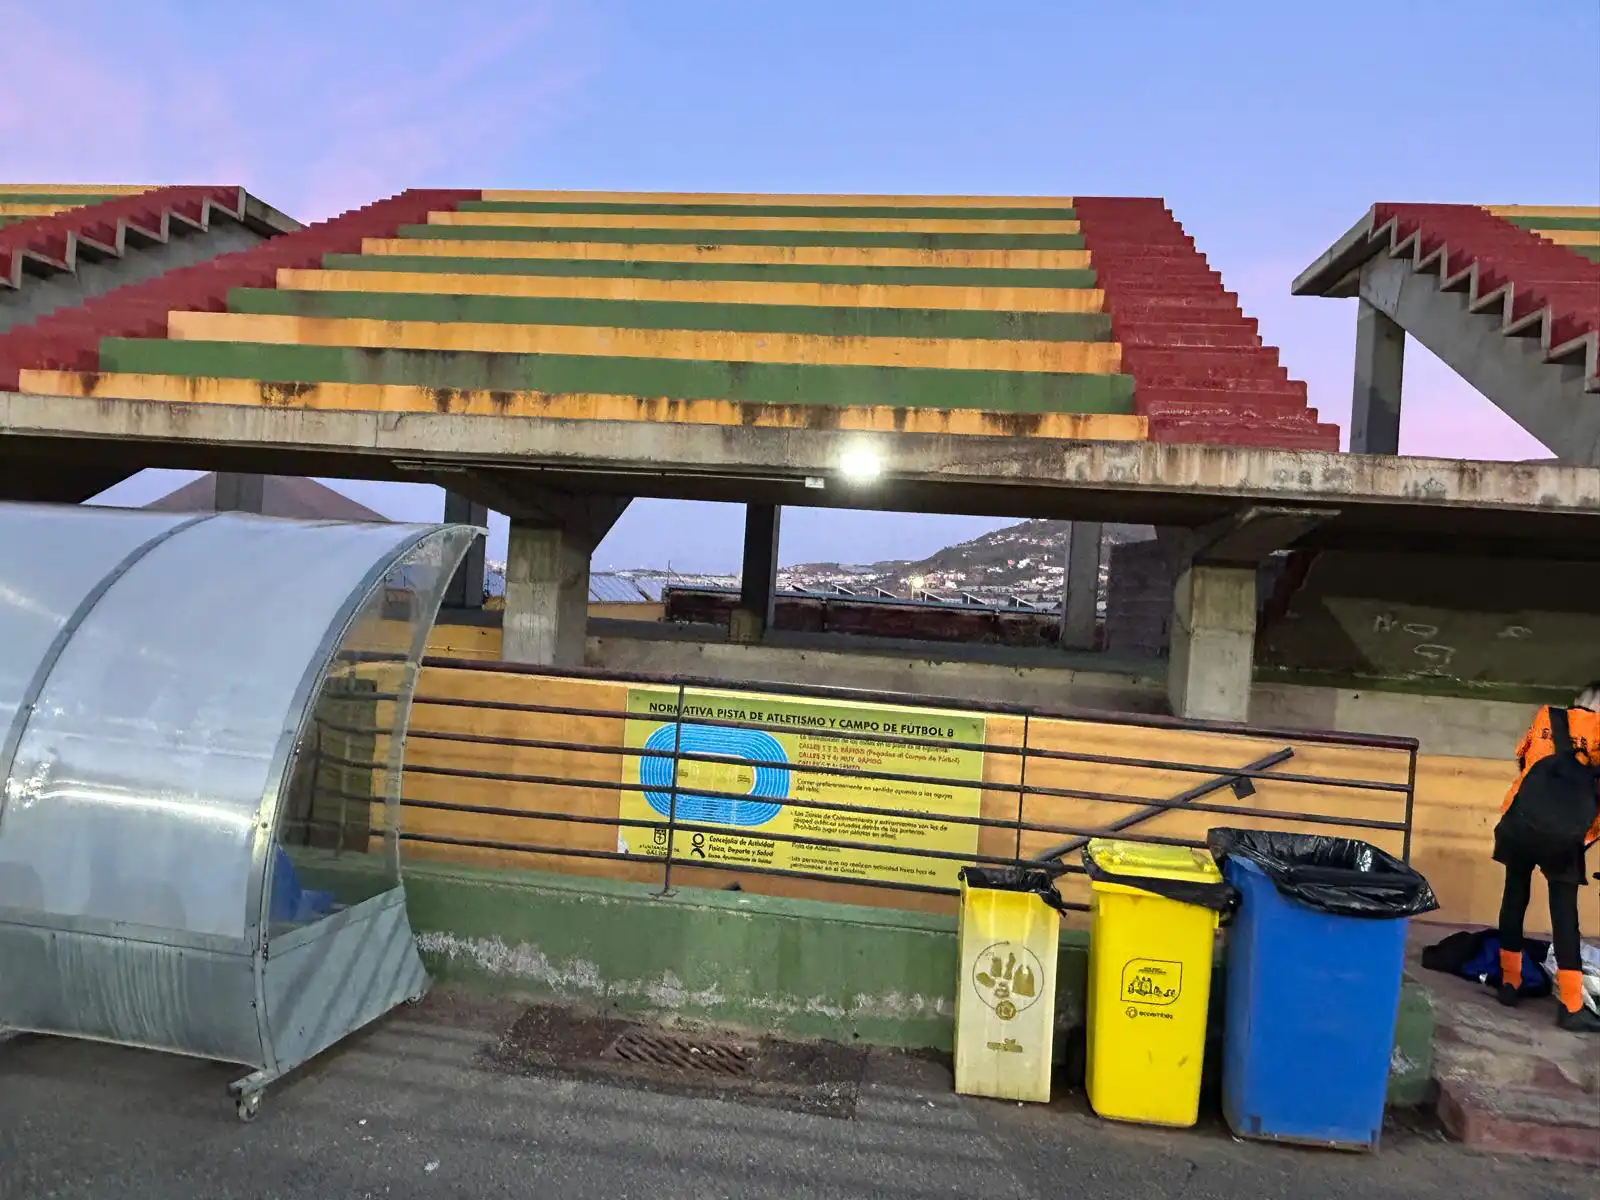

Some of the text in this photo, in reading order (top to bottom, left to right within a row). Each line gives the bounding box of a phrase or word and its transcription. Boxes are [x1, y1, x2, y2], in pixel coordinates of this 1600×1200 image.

[649, 702, 954, 737] NORMATIVA PISTA DE ATLETISMO Y CAMPO DE FÚTBOL 8
[739, 838, 746, 846] de
[748, 839, 775, 848] Actividad
[727, 845, 751, 854] Deporte
[756, 849, 774, 857] Salud
